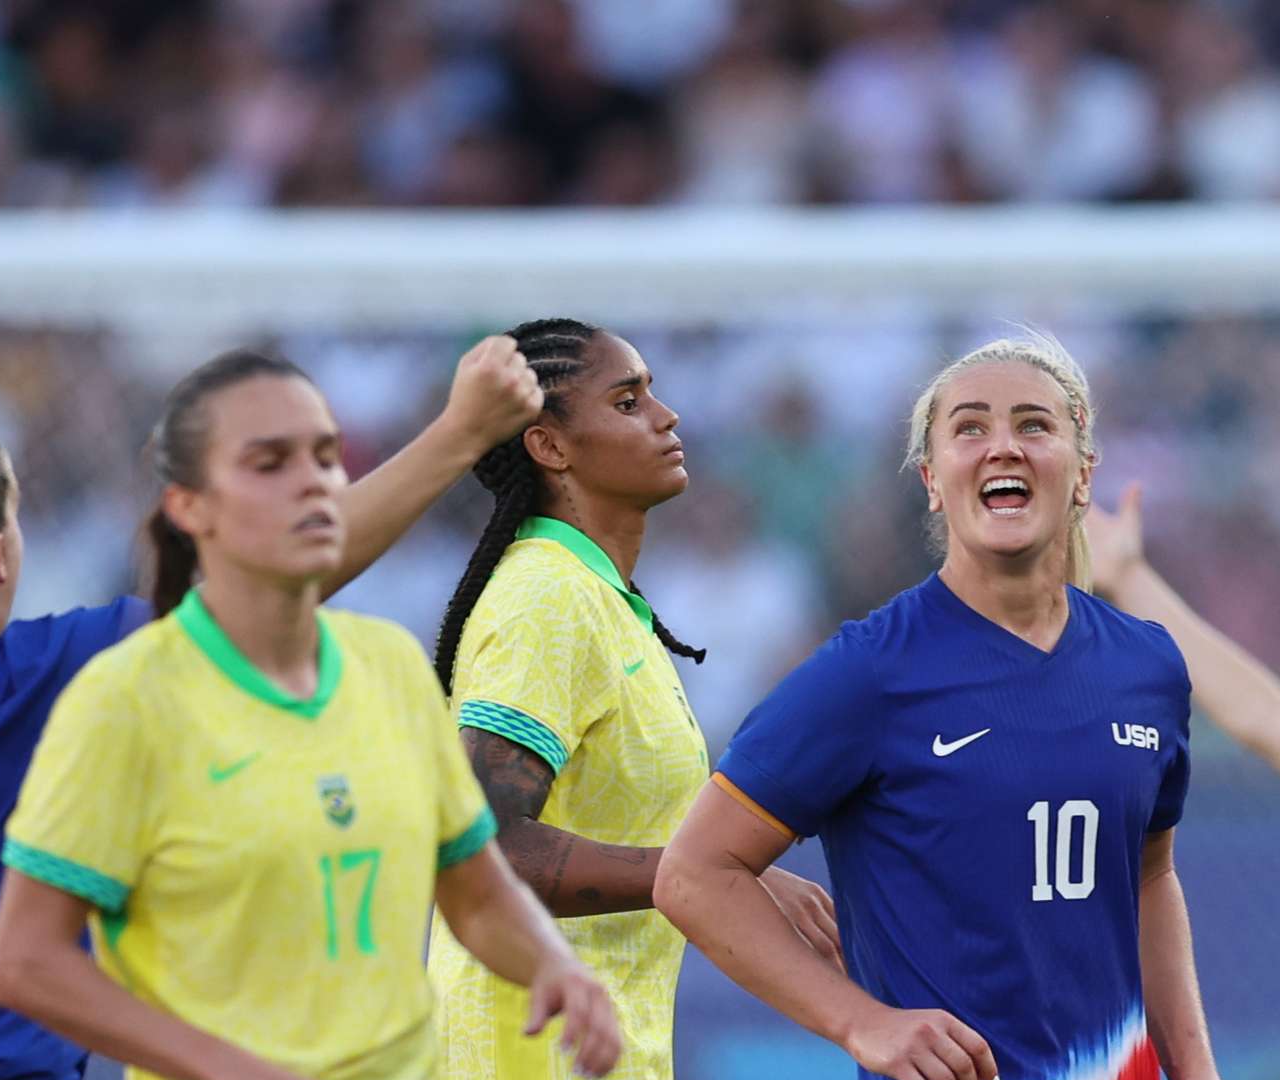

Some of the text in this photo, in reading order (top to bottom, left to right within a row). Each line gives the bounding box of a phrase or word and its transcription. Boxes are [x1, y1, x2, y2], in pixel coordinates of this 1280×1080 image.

[1112, 722, 1159, 751] USA
[1027, 800, 1099, 901] 10
[320, 848, 380, 960] 17
